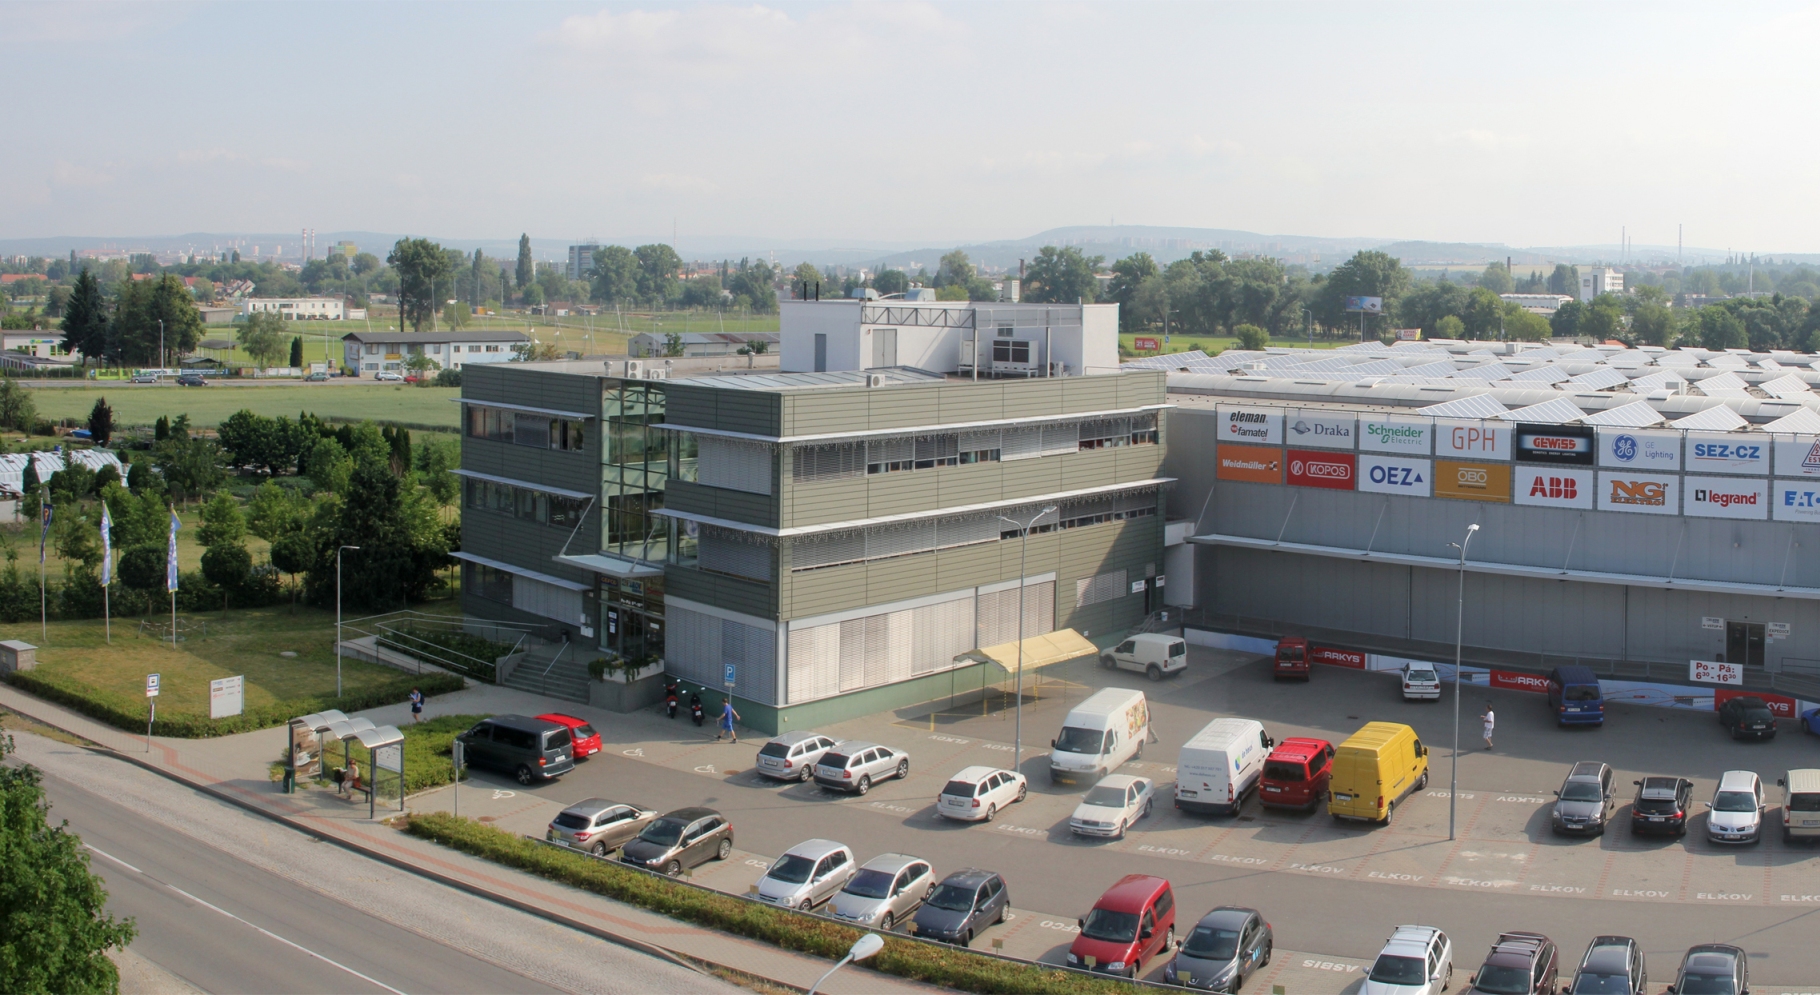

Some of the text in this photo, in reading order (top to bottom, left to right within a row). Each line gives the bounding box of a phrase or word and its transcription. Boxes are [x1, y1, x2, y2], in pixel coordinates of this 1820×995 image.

[1230, 411, 1267, 423] eleman
[1238, 427, 1268, 437] famatel
[1314, 424, 1350, 436] Draka
[1368, 424, 1423, 438] Schneider
[1391, 437, 1422, 445] Electric
[1452, 427, 1495, 451] GPH
[1645, 451, 1673, 460] Lighting
[1695, 444, 1760, 459] SEZ-CZ
[1222, 459, 1266, 470] Weidmüller
[1310, 465, 1346, 476] KOPOS
[1370, 465, 1413, 486] OEZ
[1458, 471, 1487, 482] OBO
[1529, 476, 1577, 499] ABB
[1610, 480, 1664, 498] NG
[1709, 490, 1757, 507] legrand
[1696, 662, 1708, 671] Po
[1719, 664, 1735, 673] Pá:
[1518, 676, 1549, 687] ARKY
[1766, 701, 1788, 711] KYS
[1427, 791, 1474, 799] ELOV
[871, 801, 916, 813] ELKOV
[1138, 845, 1190, 856] ELKOV
[1211, 854, 1267, 865] ELKOV
[1290, 863, 1344, 874] ELKOV
[1368, 871, 1423, 882] ELKOV
[1530, 884, 1586, 893] ELKOV
[1613, 889, 1669, 898] ELKOV
[1040, 920, 1081, 933] EFCO
[1302, 960, 1359, 972] ASBIS
